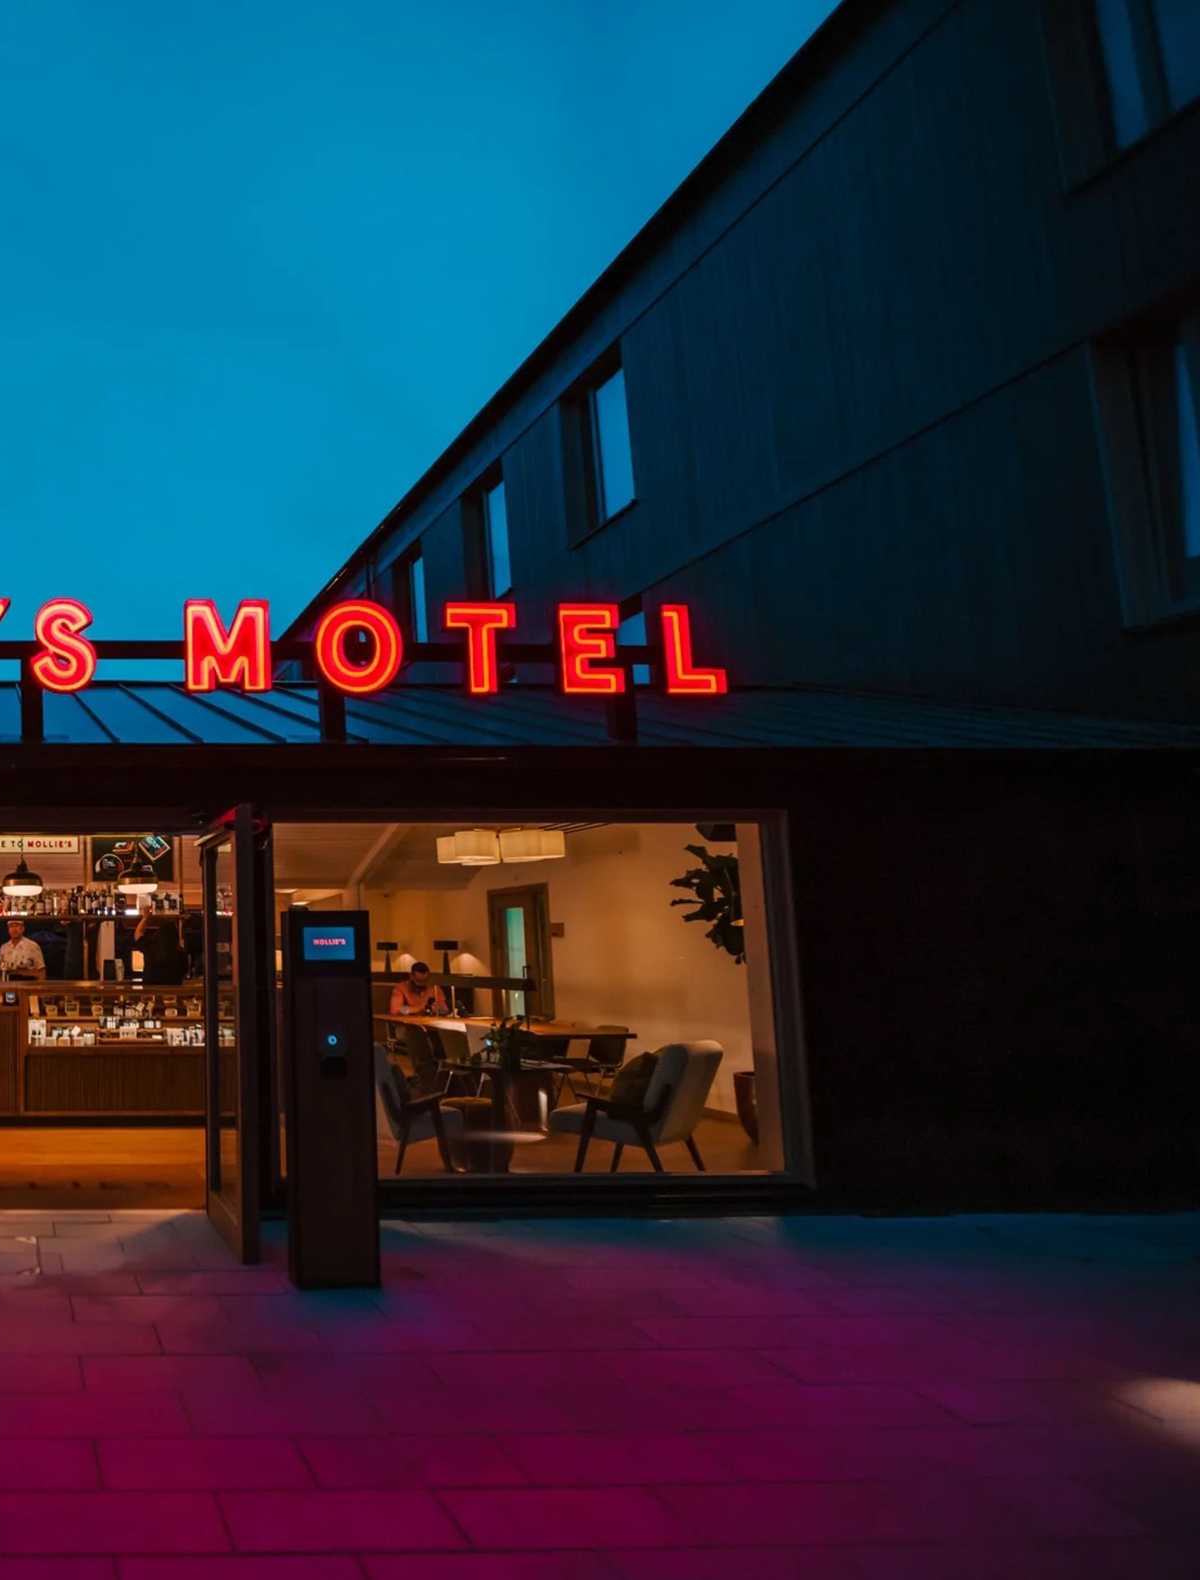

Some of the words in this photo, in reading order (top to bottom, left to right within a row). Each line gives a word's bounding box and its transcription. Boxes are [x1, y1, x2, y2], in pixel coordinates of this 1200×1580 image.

[184, 598, 728, 693] MOTEL
[11, 840, 23, 848] TO
[27, 840, 72, 848] MOLLIE'S
